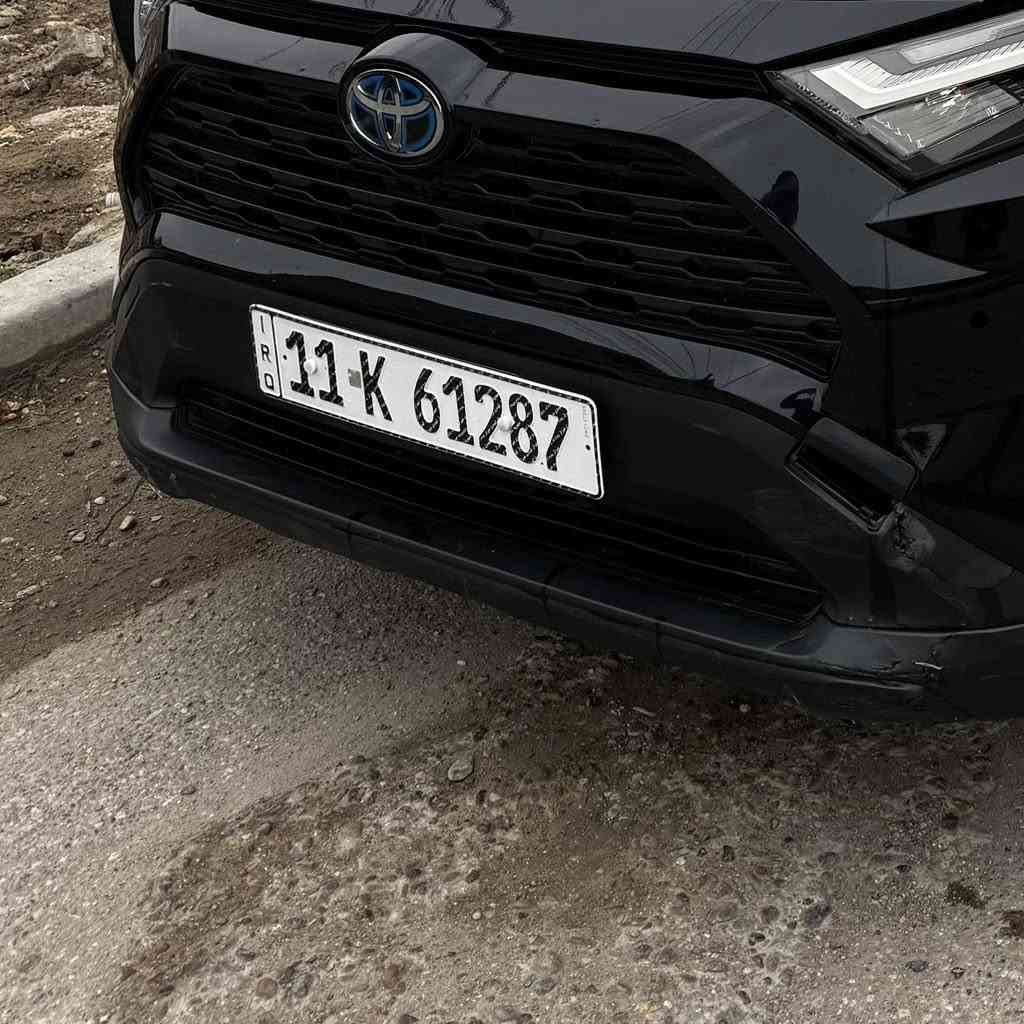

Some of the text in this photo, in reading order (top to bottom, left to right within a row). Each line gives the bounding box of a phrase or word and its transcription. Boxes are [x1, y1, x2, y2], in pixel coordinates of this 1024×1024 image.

[259, 315, 275, 391] IRQ
[284, 330, 344, 407] 11
[359, 351, 393, 422] K
[413, 368, 570, 472] 61287
